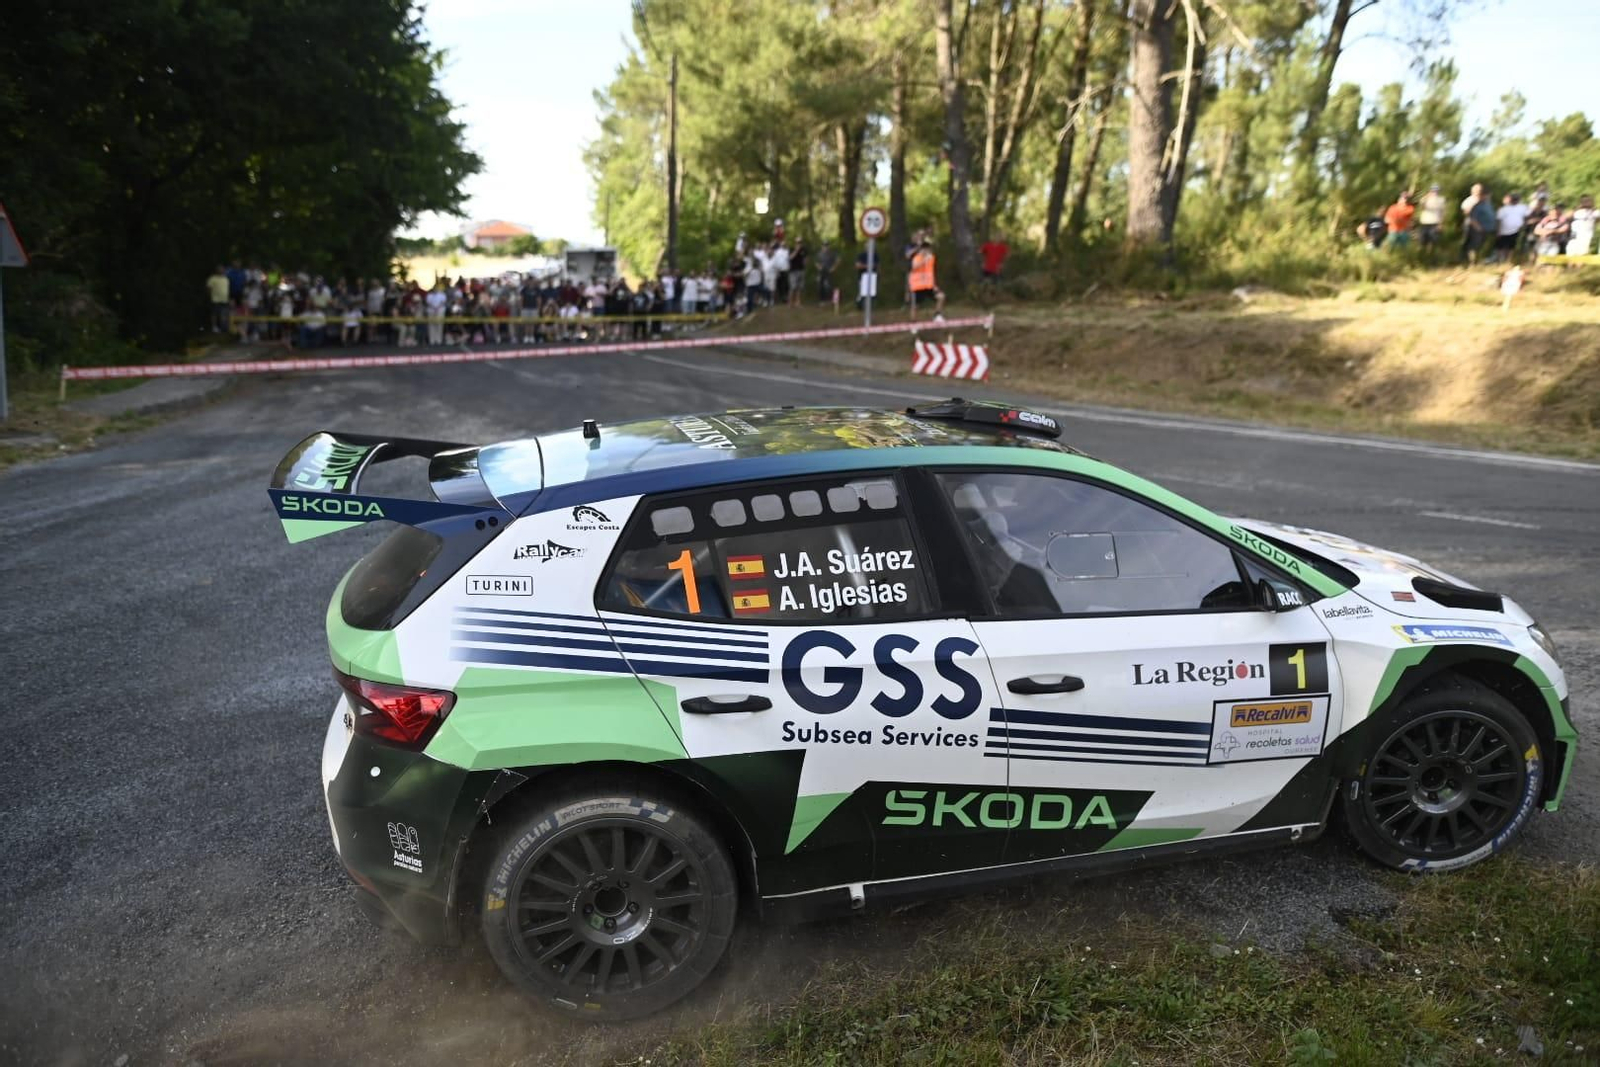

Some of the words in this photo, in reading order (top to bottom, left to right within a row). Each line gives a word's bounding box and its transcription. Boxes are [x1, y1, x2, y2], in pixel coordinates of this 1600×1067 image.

[566, 524, 597, 532] Escapes
[774, 551, 822, 579] J.A.
[827, 546, 915, 575] Suárez
[472, 580, 527, 591] TURINI
[667, 549, 701, 614] 1
[779, 586, 806, 611] A.
[809, 579, 908, 614] Iglesias
[1430, 629, 1507, 641] MICHELIN
[781, 629, 983, 720] GSS
[1132, 664, 1170, 686] La
[1175, 658, 1265, 687] Región
[1288, 649, 1306, 689] 1
[1246, 706, 1297, 722] Recalvi
[782, 720, 872, 745] Subsea
[881, 723, 979, 748] Services
[1245, 736, 1292, 749] recoletas
[1294, 734, 1321, 746] salud
[1247, 728, 1283, 736] HOSPITAL
[393, 849, 422, 868] Asturias
[497, 820, 552, 884] MICHELIN
